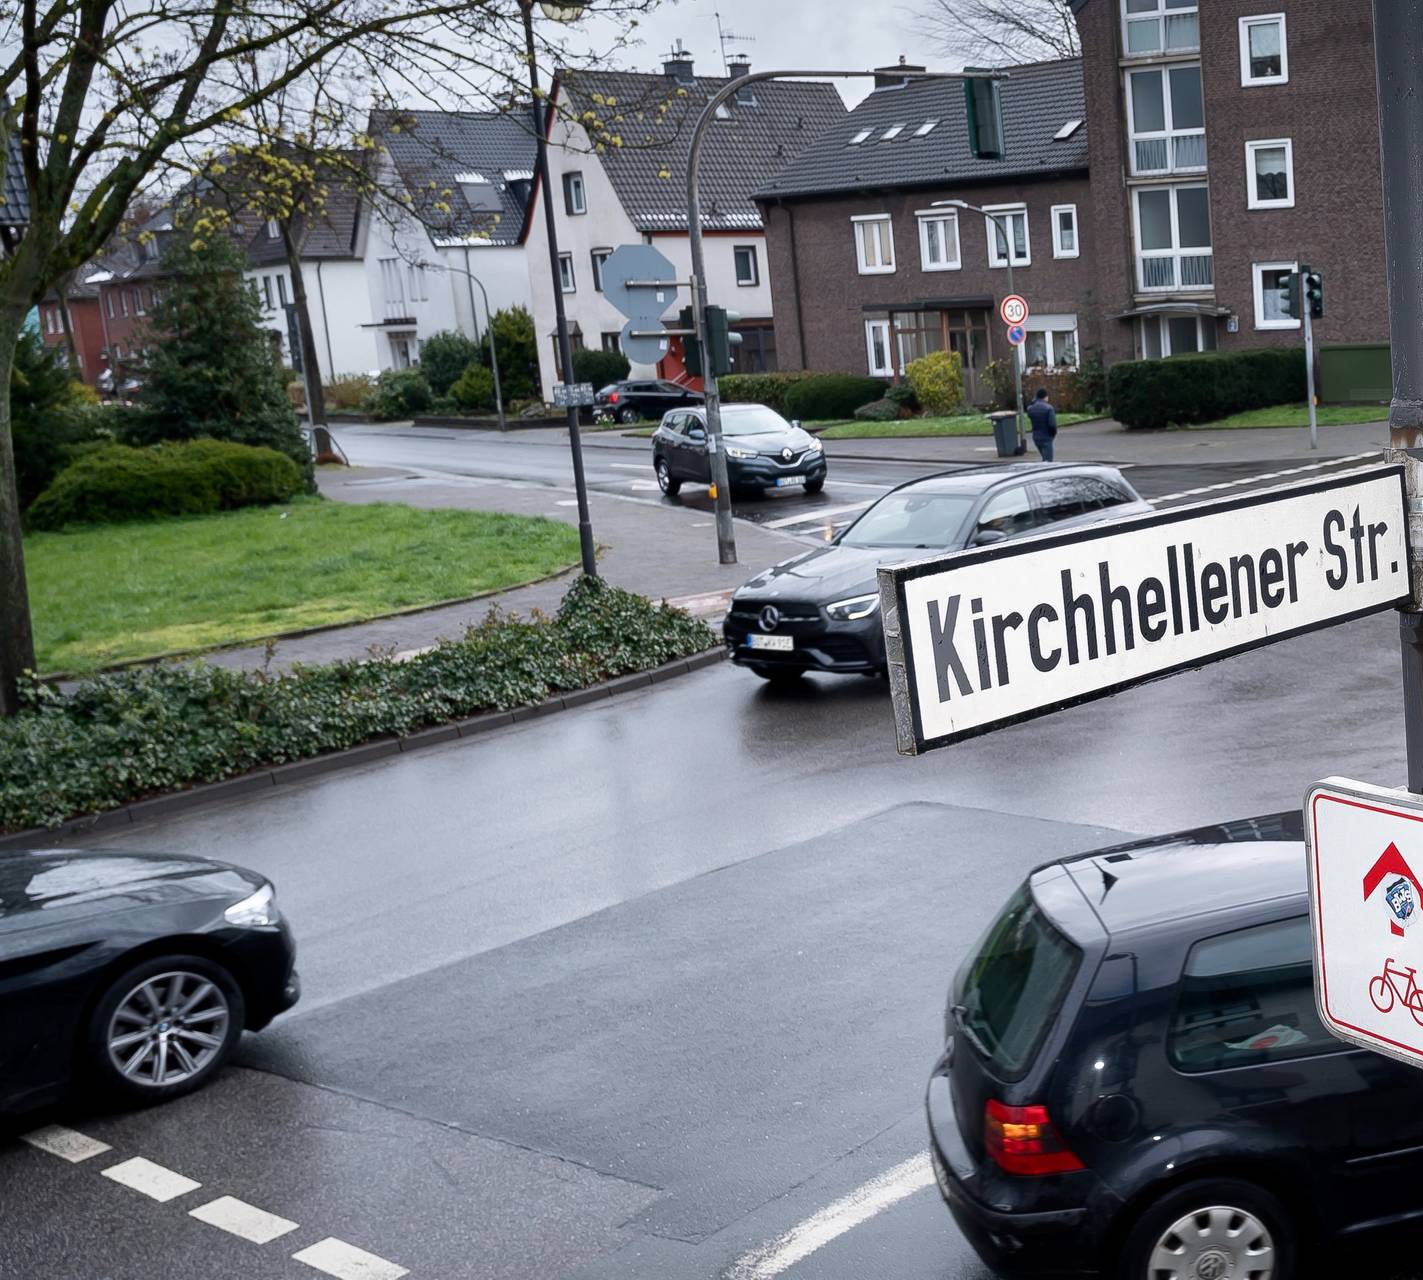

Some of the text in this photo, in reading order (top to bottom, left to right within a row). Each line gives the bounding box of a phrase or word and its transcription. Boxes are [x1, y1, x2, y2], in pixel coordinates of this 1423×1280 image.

[1007, 304, 1022, 317] 30
[927, 503, 1399, 704] Kirchhellener Str.
